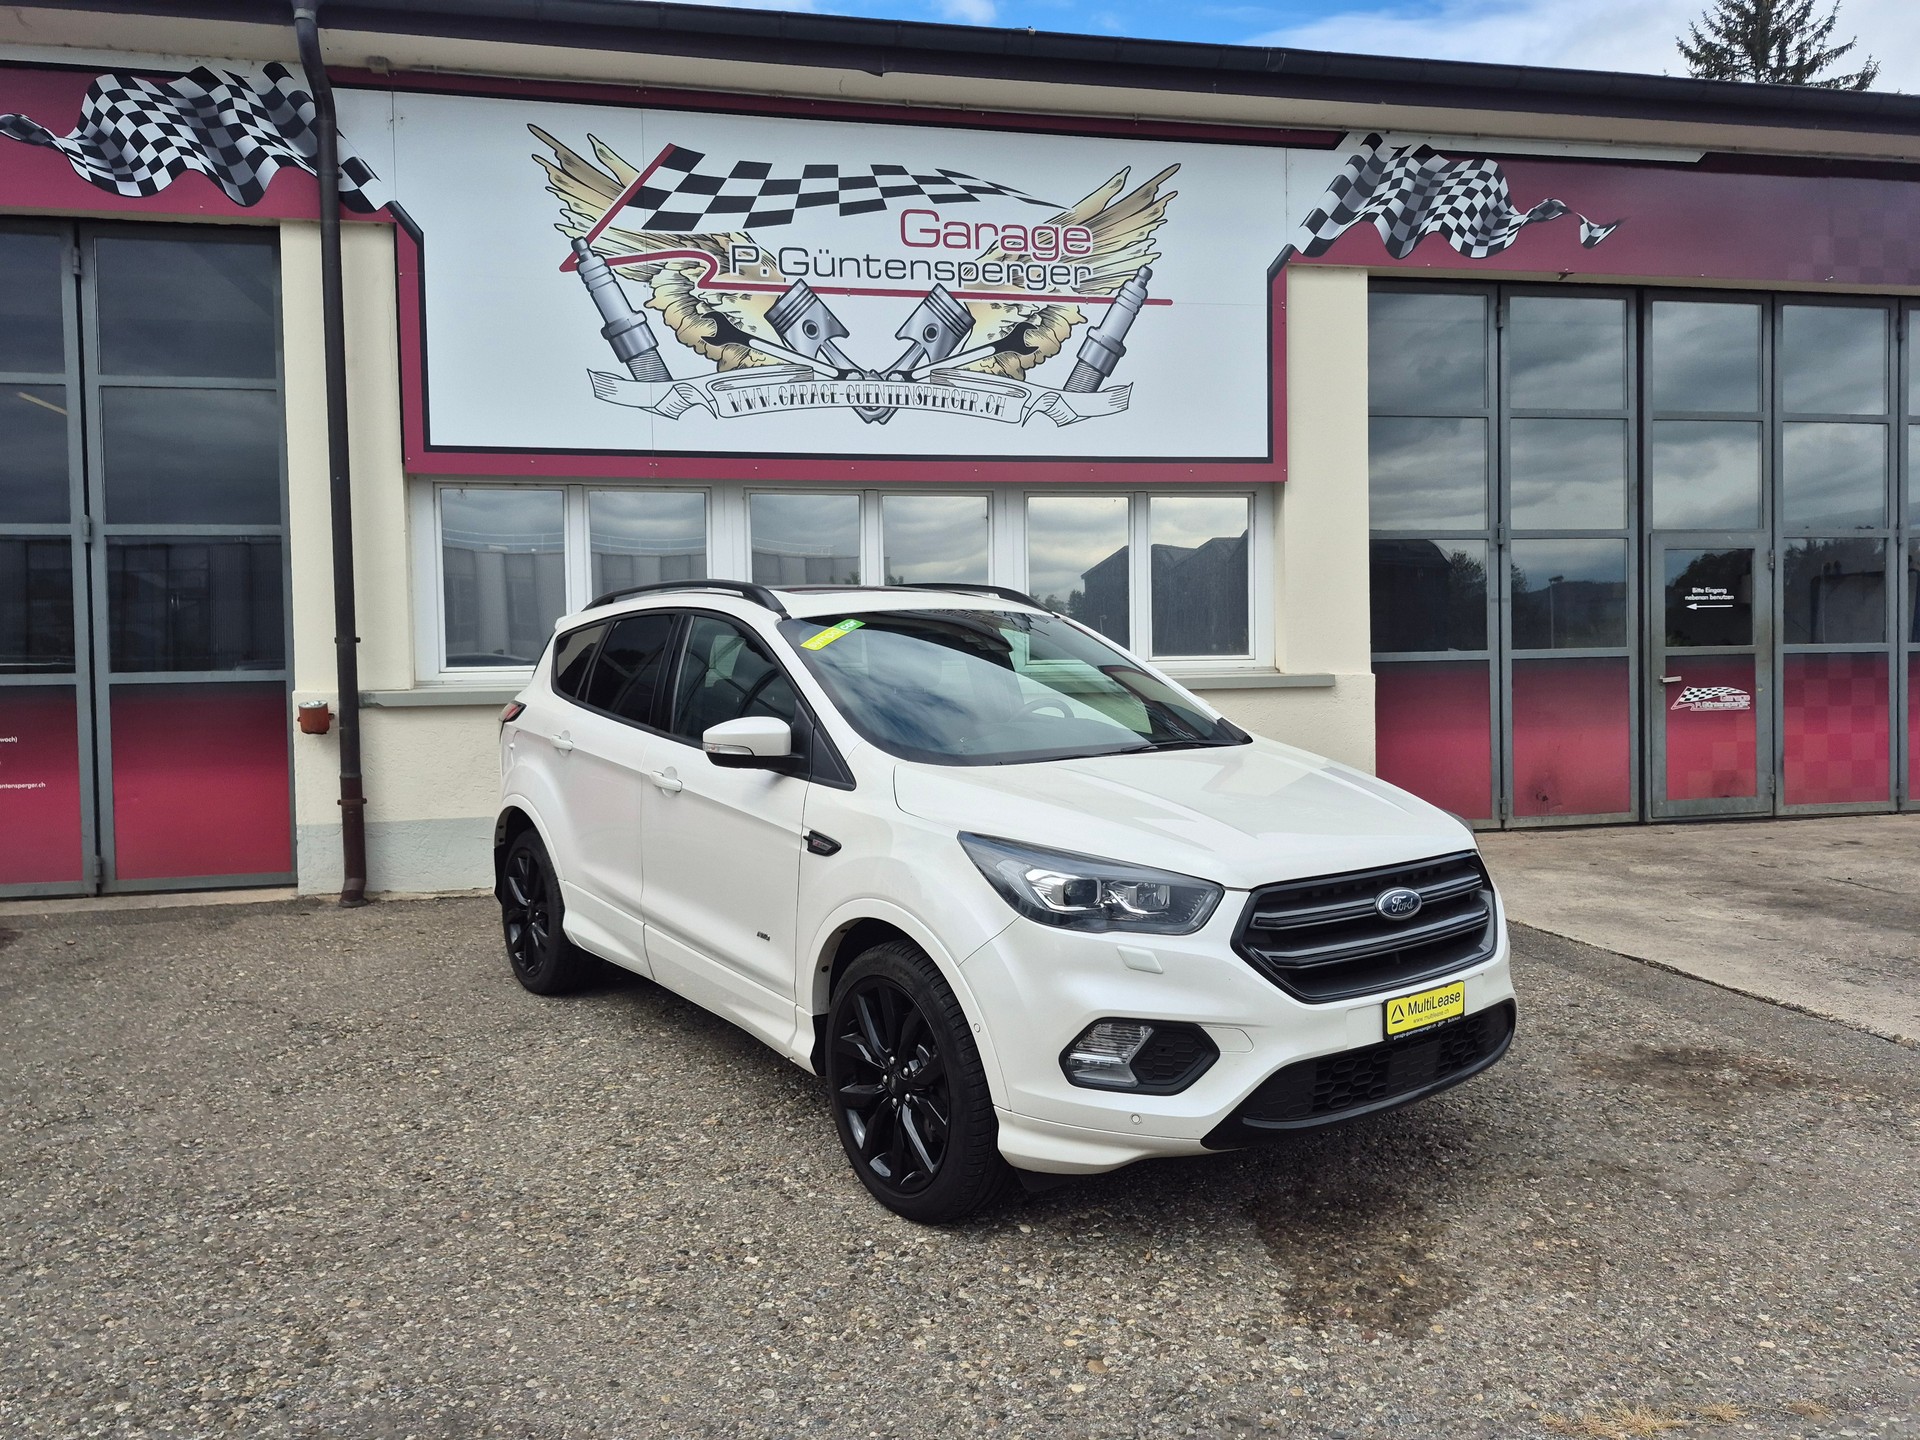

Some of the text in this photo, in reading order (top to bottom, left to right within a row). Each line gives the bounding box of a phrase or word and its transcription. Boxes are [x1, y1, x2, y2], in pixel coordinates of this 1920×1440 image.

[900, 208, 1092, 262] Garage
[731, 245, 1092, 291] P. Güntensperger
[727, 383, 1007, 417] WWW.GARAGE-GUENTENSPERGER.CH
[1705, 586, 1727, 595] Eingang
[1391, 895, 1415, 912] Ford
[1407, 991, 1461, 1017] MultiLease
